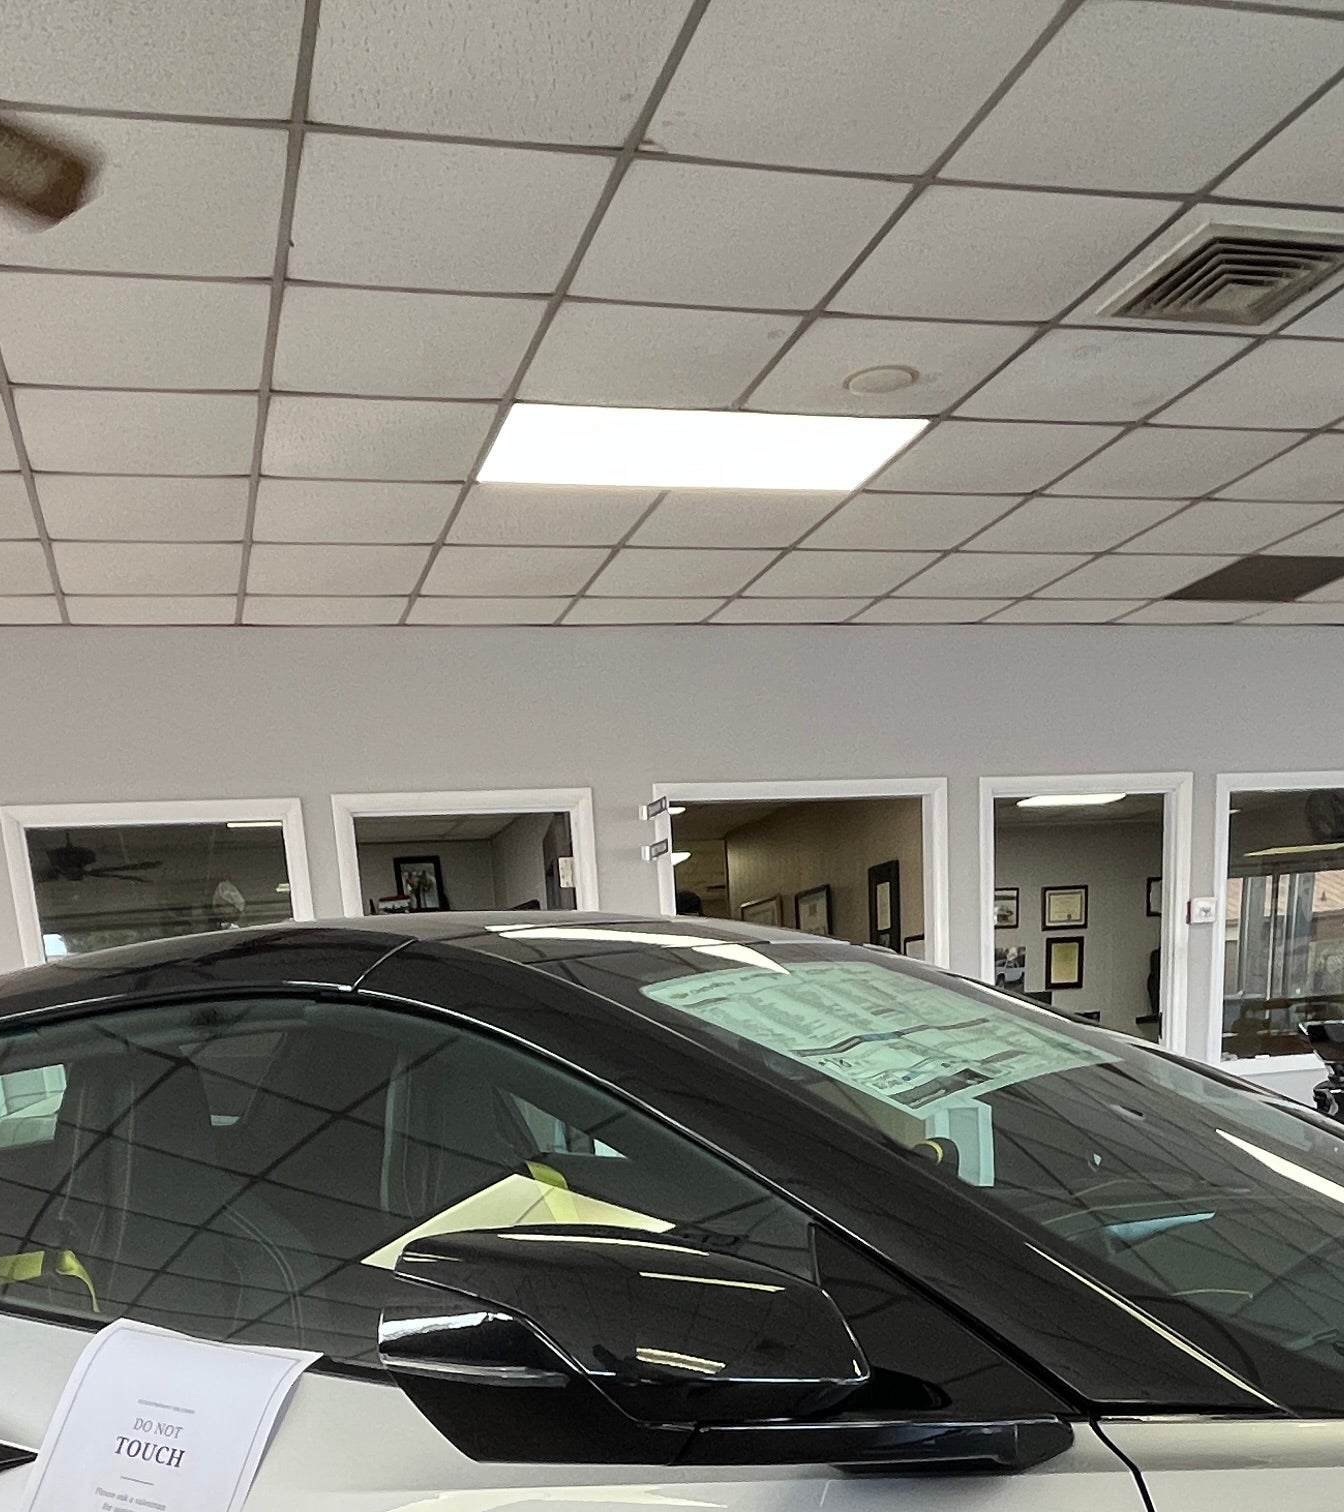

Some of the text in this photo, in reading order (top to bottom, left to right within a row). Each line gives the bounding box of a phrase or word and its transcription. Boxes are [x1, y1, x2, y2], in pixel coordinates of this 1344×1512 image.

[134, 1418, 183, 1438] DO NOT
[114, 1435, 186, 1468] TOUCH
